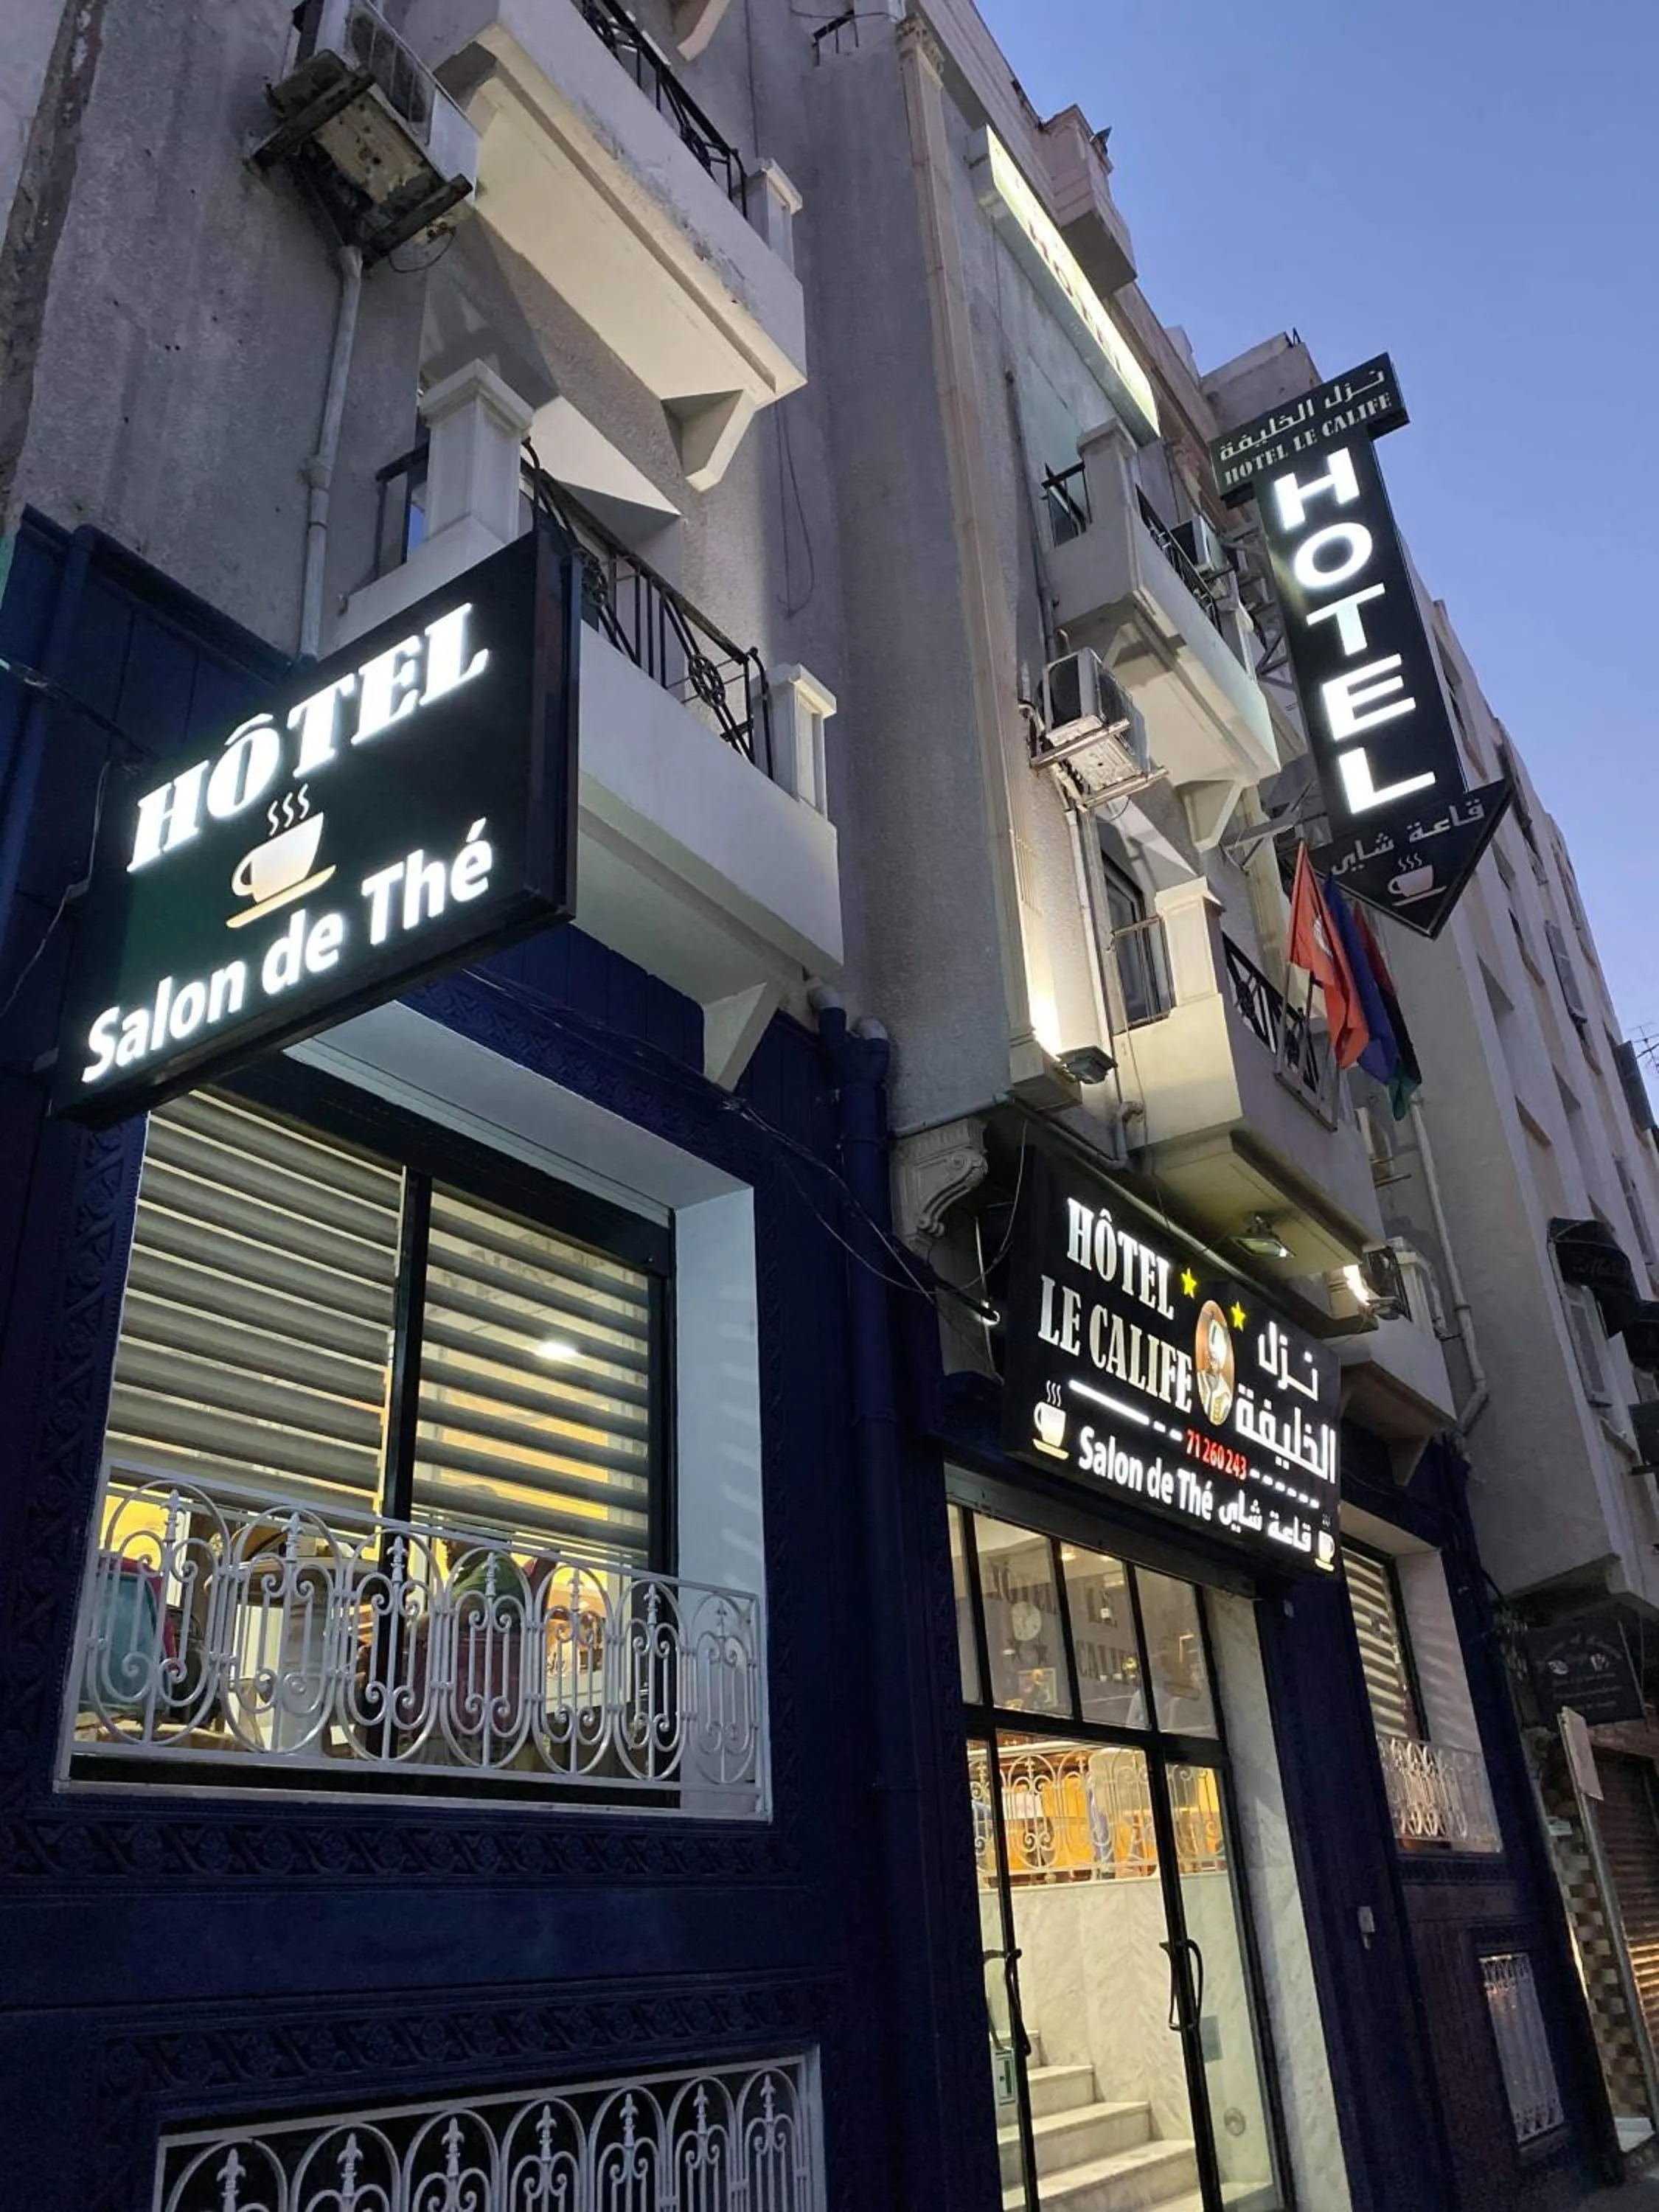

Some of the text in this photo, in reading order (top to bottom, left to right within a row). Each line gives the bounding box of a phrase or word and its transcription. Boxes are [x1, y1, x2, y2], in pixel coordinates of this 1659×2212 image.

[1220, 398, 1315, 461] الخليفة
[1293, 428, 1318, 452] LE
[1322, 392, 1392, 437] CALIFE
[1273, 447, 1437, 815] HOTEL
[126, 602, 490, 873] HÔTEL
[1406, 799, 1485, 844] قاعة
[82, 817, 493, 1083] Salon de Thé
[1067, 1197, 1175, 1320] HÔTEL
[1037, 1274, 1192, 1413] LE CALIFE
[1079, 1425, 1214, 1521] Salon de Thé
[1186, 1428, 1247, 1481] 71 260 243
[1236, 1382, 1336, 1484] الخليفة
[1267, 1510, 1312, 1553] قاعة
